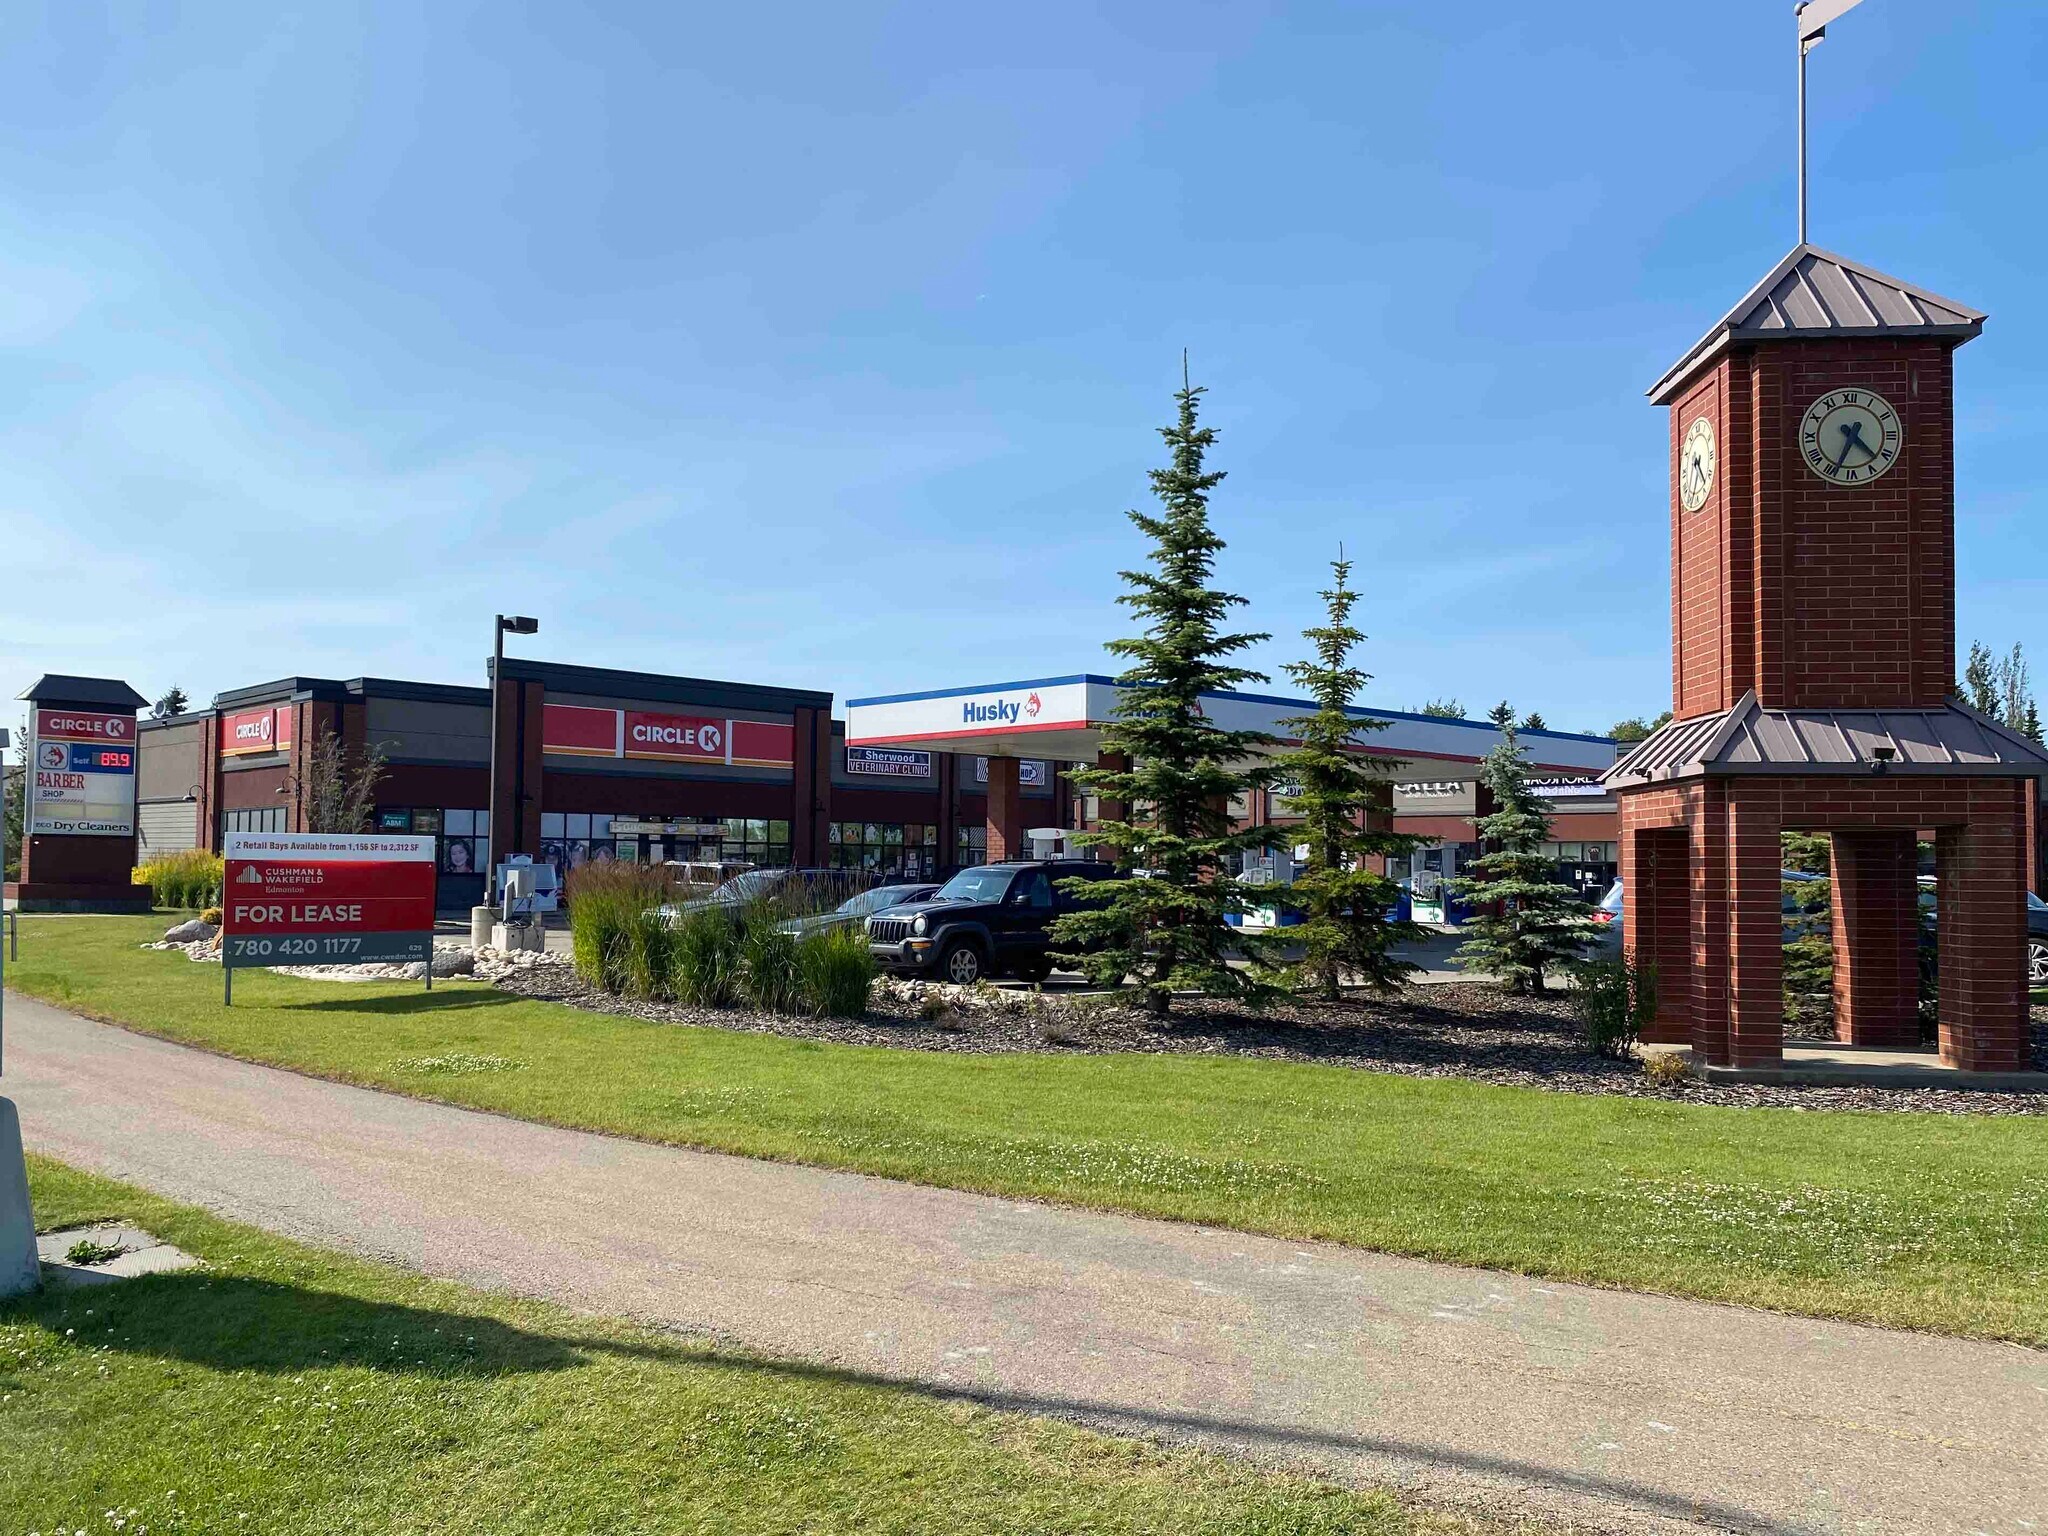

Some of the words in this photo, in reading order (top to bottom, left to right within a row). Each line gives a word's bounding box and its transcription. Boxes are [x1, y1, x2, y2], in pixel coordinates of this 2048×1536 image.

[1823, 397, 1836, 410] XI
[1842, 393, 1857, 403] XII
[1809, 413, 1821, 423] X
[1805, 432, 1816, 443] IX
[1886, 430, 1897, 440] III
[963, 699, 1021, 724] Husky
[49, 718, 102, 732] CIRCLE
[108, 720, 123, 736] K
[632, 725, 694, 745] CIRCLE
[700, 727, 719, 750] K
[865, 750, 915, 762] Sherwood
[850, 761, 900, 773] VETERINARY
[902, 764, 928, 775] CLINIC
[1020, 768, 1033, 778] HOP
[37, 772, 85, 789] BARBER
[42, 789, 64, 798] SHOP
[53, 821, 75, 832] Dry
[77, 821, 130, 832] Cleaners
[235, 841, 241, 849] 2
[243, 841, 267, 850] Retail
[269, 841, 289, 851] Bays
[290, 842, 327, 850] Available
[369, 843, 379, 851] SF
[380, 843, 388, 851] to
[389, 843, 409, 852] 2,312
[410, 843, 419, 851] SF
[265, 868, 314, 876] CUSHMAN
[316, 868, 323, 876] &
[265, 876, 324, 884] WAKEFIELD
[234, 905, 284, 923] FOR
[291, 904, 362, 922] LEASE
[234, 940, 272, 956] 780
[278, 939, 318, 955] 420
[323, 938, 362, 954] 1177
[360, 953, 424, 961] www.cwedm.com
